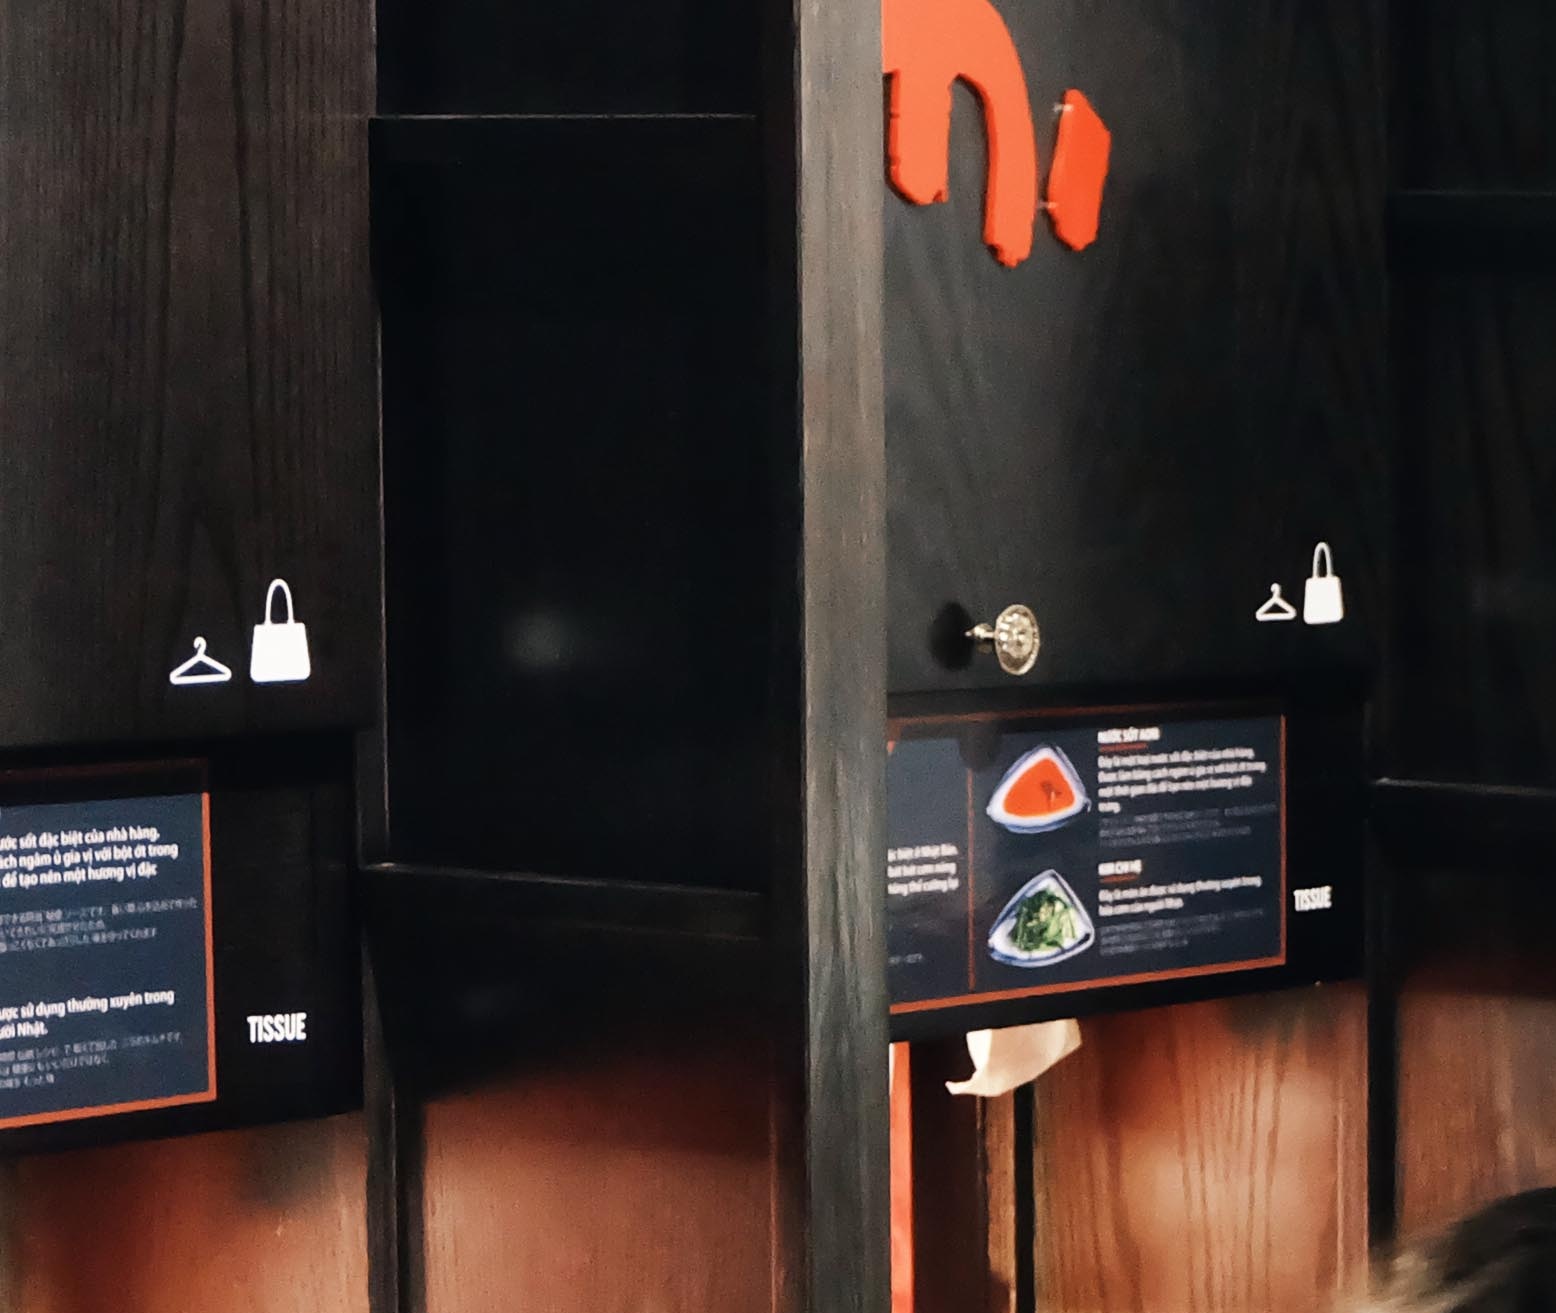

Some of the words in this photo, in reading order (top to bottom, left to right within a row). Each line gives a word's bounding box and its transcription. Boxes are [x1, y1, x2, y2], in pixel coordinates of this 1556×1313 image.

[148, 843, 179, 860] trong
[1294, 886, 1331, 911] TISSUE
[144, 990, 175, 1005] trong
[247, 1012, 307, 1043] TISSUE
